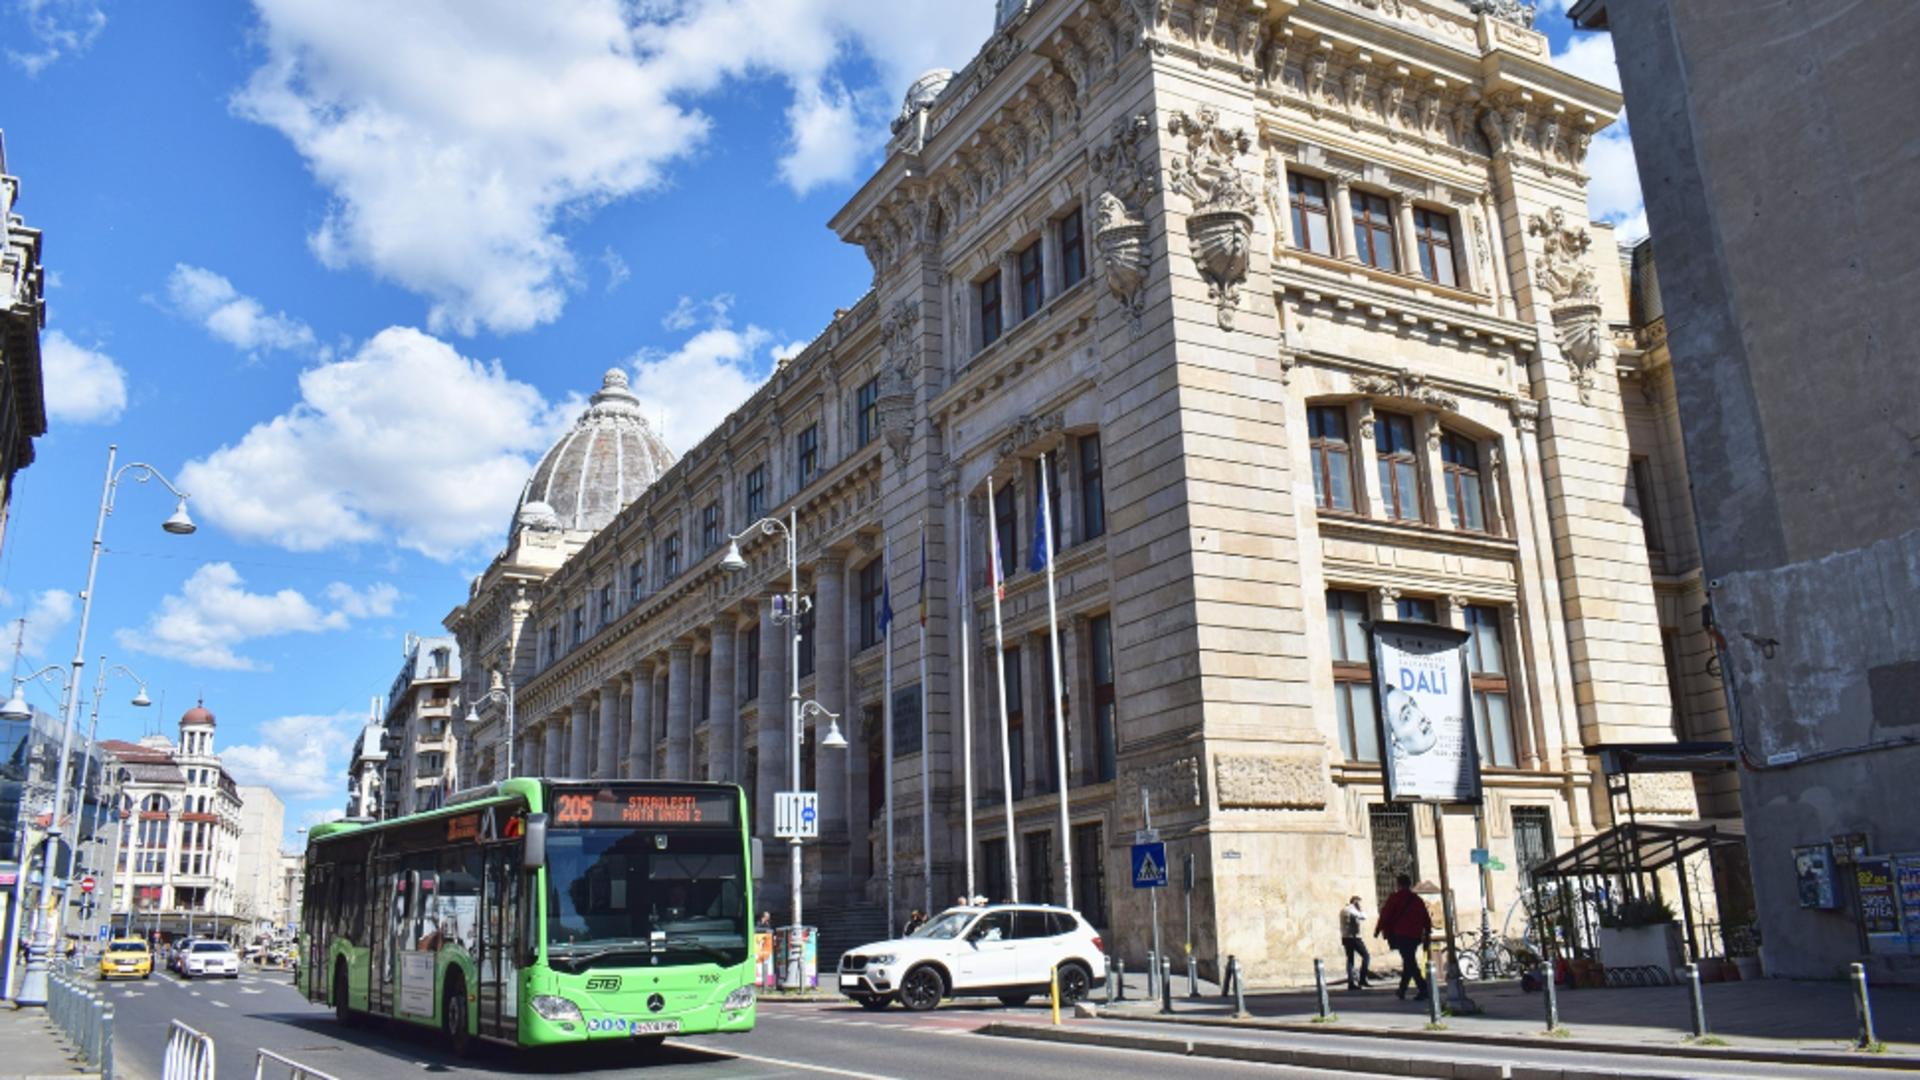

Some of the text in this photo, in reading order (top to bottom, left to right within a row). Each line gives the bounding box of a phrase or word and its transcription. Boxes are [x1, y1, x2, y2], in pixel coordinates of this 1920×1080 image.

[1399, 666, 1447, 695] DALÍ
[558, 795, 593, 821] 205
[694, 810, 702, 822] 2
[586, 977, 619, 990] STB
